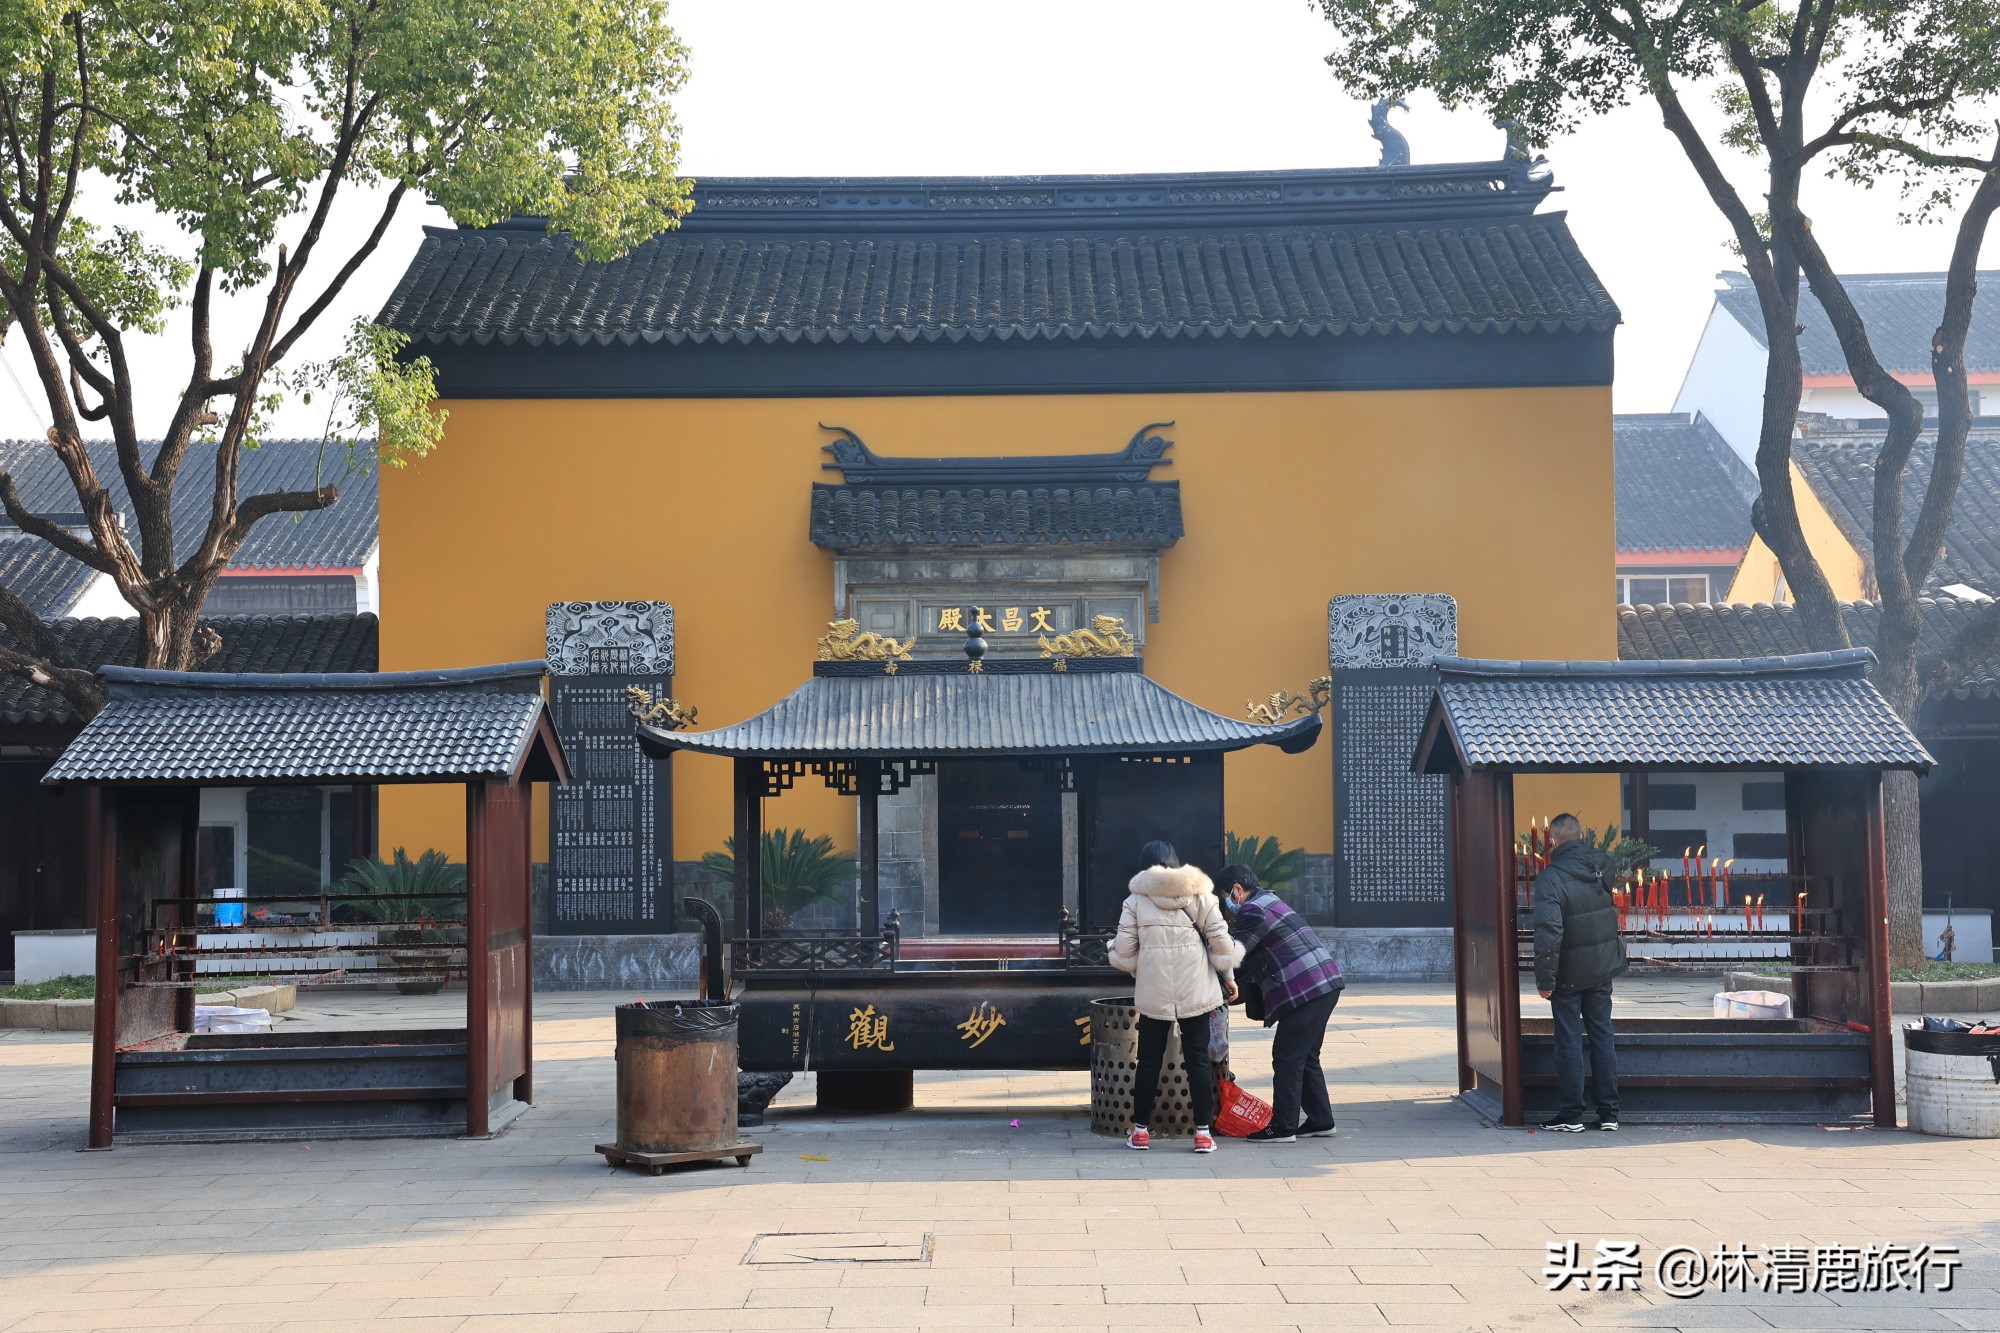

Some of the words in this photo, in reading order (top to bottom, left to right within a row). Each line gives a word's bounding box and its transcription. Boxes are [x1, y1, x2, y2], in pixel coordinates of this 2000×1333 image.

[938, 606, 1056, 633] 文昌大殿
[884, 660, 899, 676] 壽
[1052, 658, 1068, 673] 福
